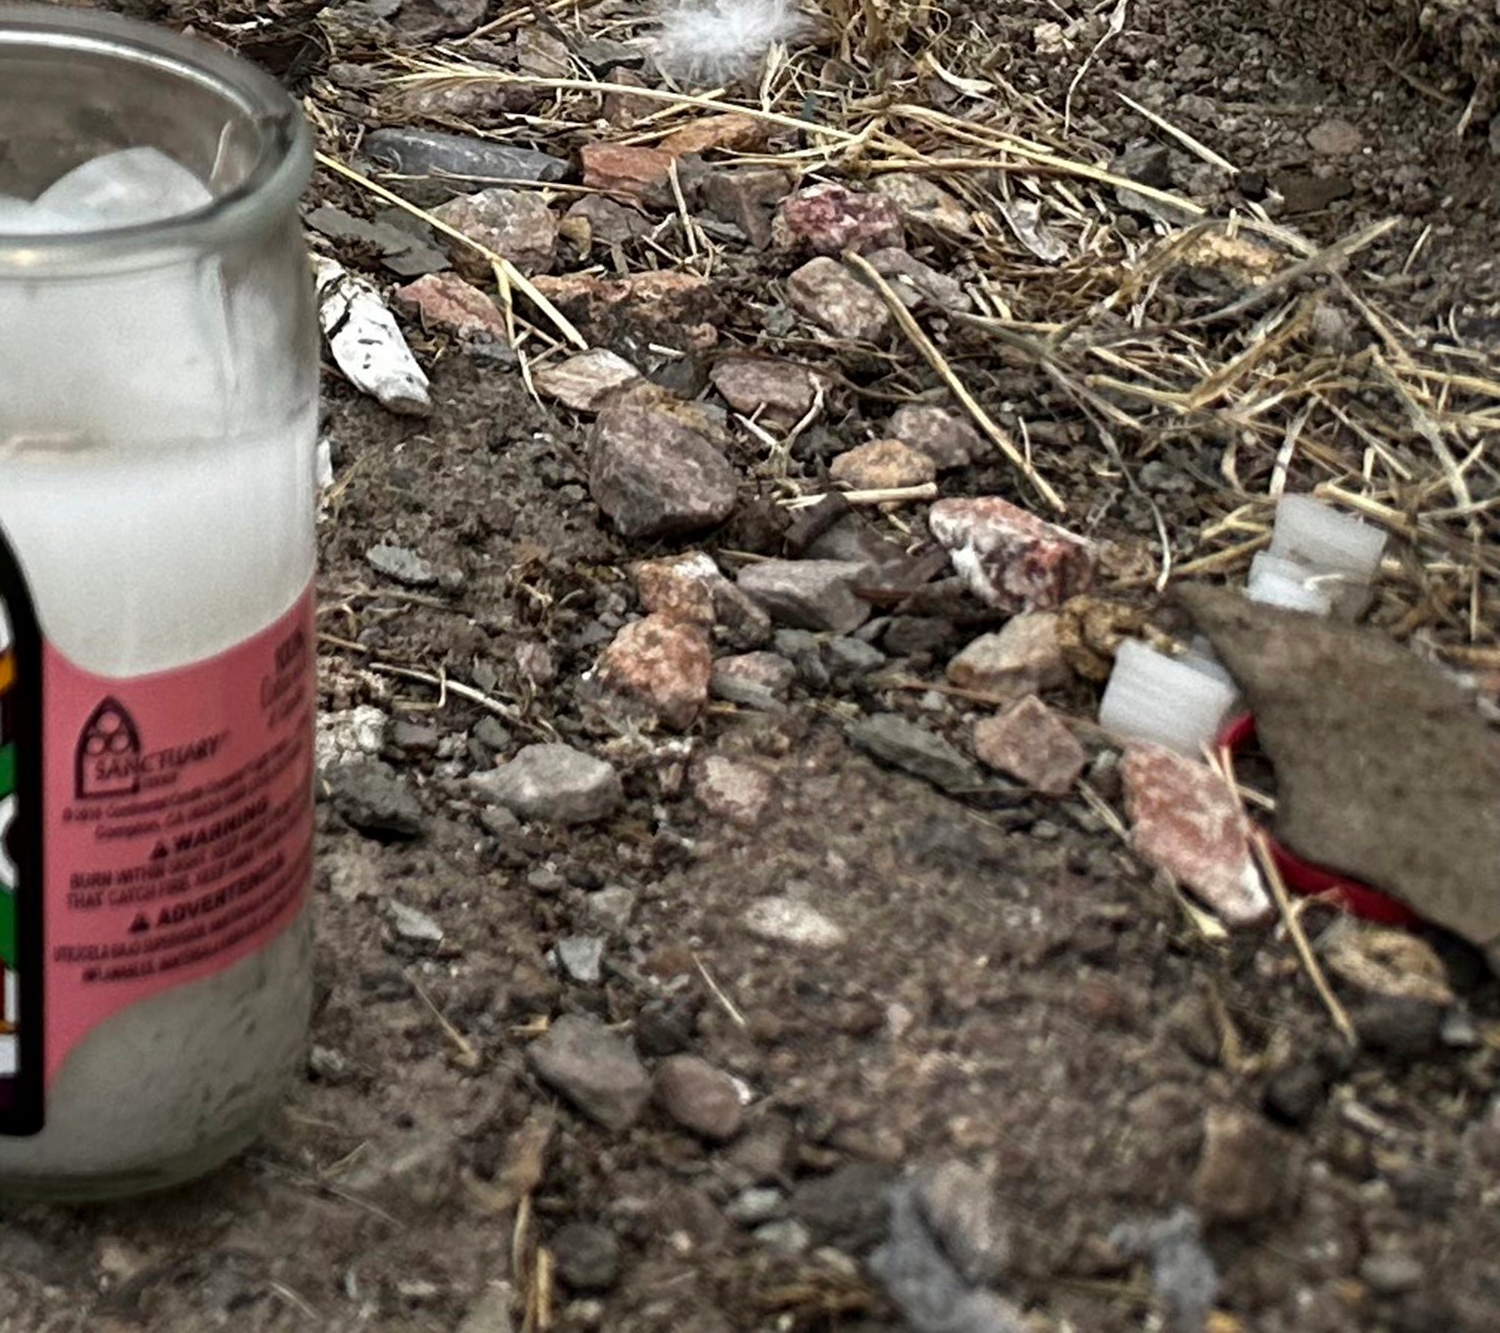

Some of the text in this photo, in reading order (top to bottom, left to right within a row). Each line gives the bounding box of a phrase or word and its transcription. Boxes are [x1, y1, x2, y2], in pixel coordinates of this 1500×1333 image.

[95, 734, 224, 780] SANCTUARY
[174, 795, 270, 851] WARNING
[70, 869, 112, 889] BURN
[116, 863, 165, 884] WITHIN
[67, 890, 103, 910] THAT
[108, 882, 156, 906] CATCH
